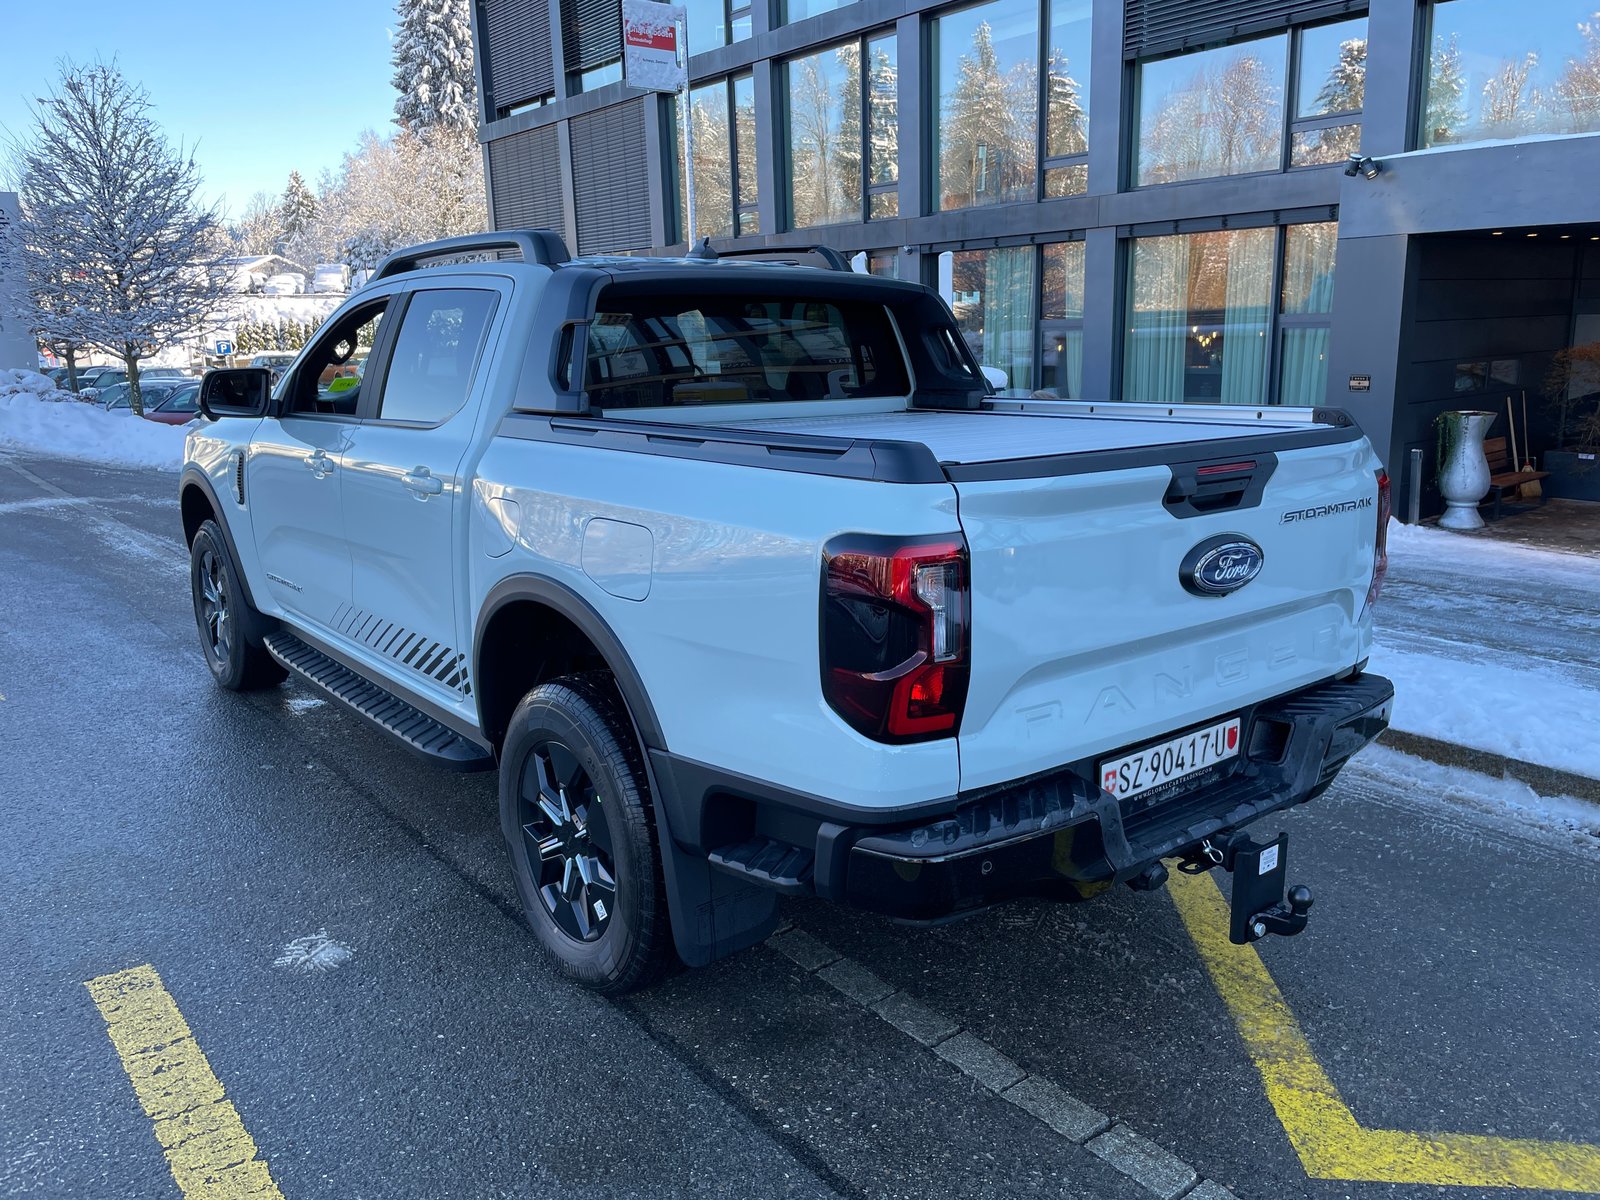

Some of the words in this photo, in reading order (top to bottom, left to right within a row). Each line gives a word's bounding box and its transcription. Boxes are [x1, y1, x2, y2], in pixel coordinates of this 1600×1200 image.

[220, 344, 227, 353] P
[1280, 497, 1373, 524] STORMTRAK
[1214, 553, 1252, 581] Ford
[1014, 624, 1341, 740] RANGER
